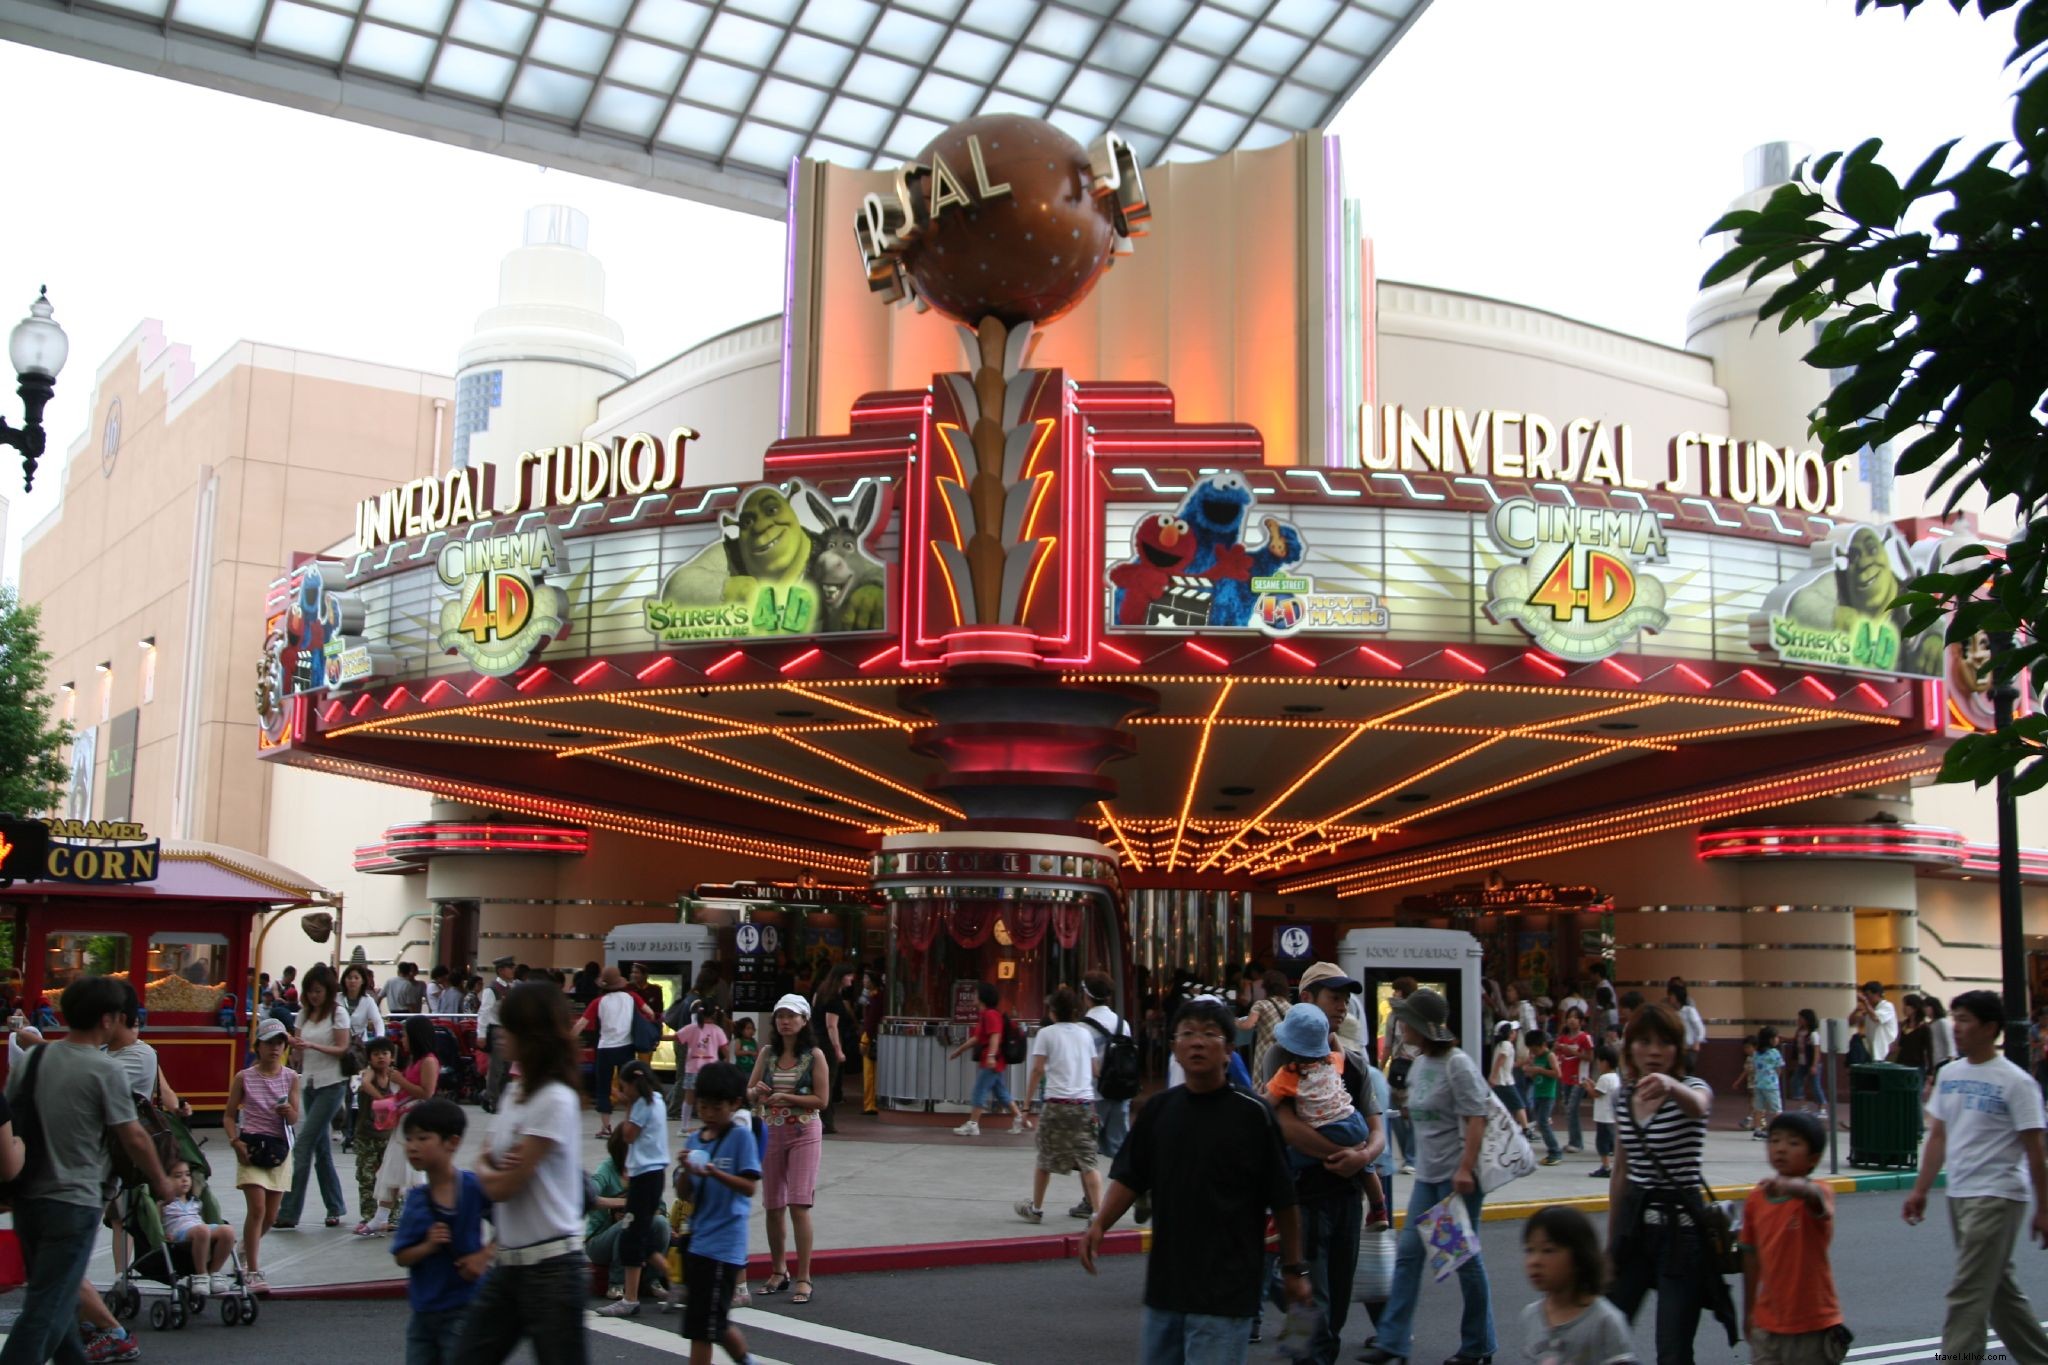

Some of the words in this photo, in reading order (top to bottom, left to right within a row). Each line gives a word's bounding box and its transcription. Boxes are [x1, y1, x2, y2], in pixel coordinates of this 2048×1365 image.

[1360, 403, 1649, 491] UNIVERSAL
[1665, 429, 1853, 516] STUDIOS
[355, 461, 496, 551] UNIVERSAL
[504, 426, 697, 515] STUDIOS
[1494, 497, 1668, 557] CINEMA
[437, 526, 556, 587] CINEMA
[1254, 580, 1280, 590] SESAME
[1282, 580, 1305, 590] STREET
[1308, 596, 1372, 609] MOVIE
[1308, 609, 1385, 626] MAGIC
[48, 847, 155, 880] CORN
